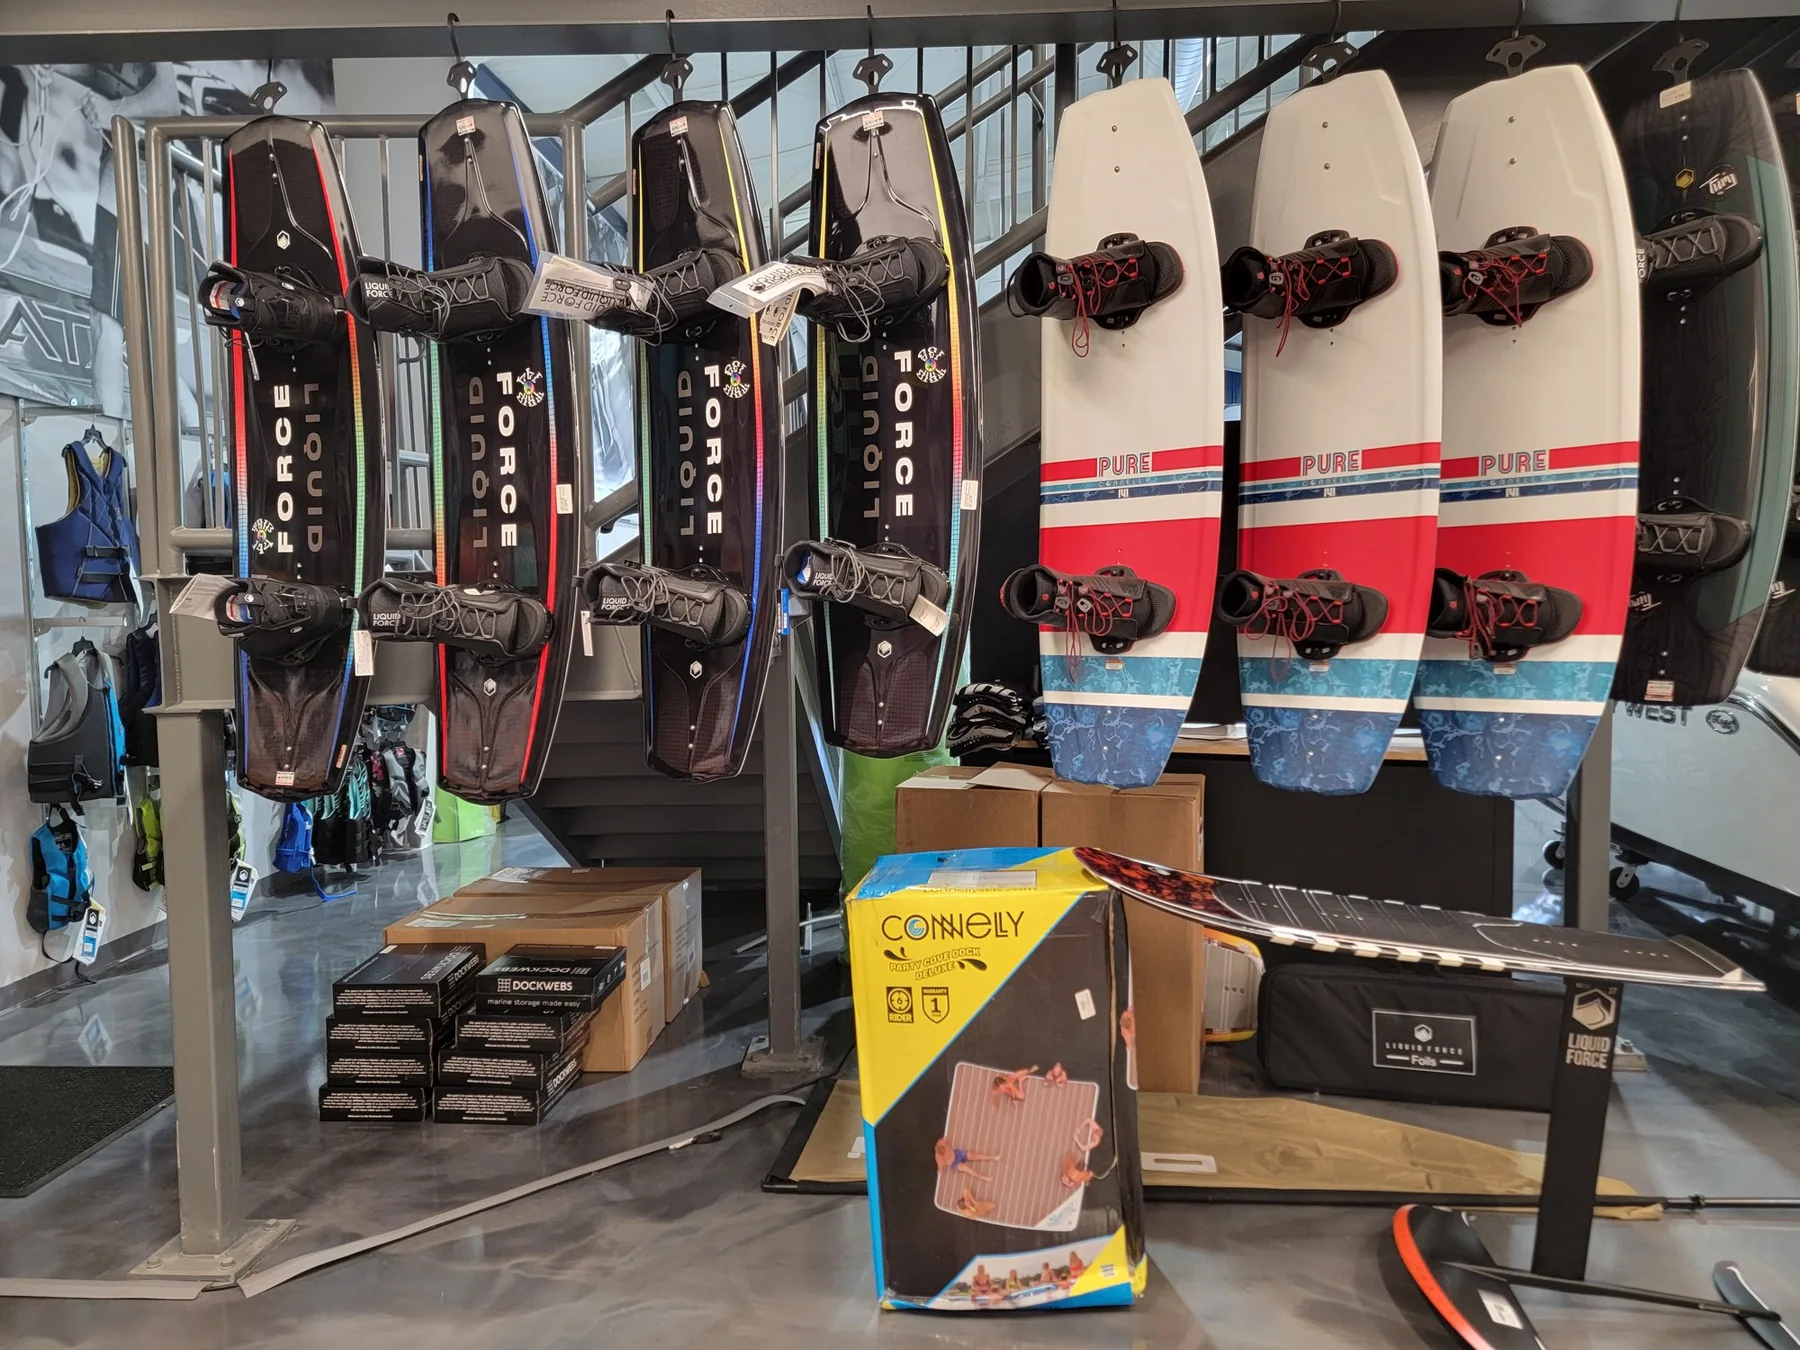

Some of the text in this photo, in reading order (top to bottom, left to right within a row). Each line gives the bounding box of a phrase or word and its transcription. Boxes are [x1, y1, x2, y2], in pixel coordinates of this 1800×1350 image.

[541, 291, 583, 309] FORCE
[862, 350, 914, 518] LIQUID FORCE
[468, 371, 517, 547] LIQUID FORCE
[677, 365, 723, 535] LIQUID FORCE
[273, 383, 323, 553] LIQUID FORCE
[1098, 451, 1151, 477] PURE
[1301, 449, 1360, 476] PURE
[1480, 449, 1547, 476] PURE
[602, 597, 627, 605] LIQUID
[1624, 701, 1693, 727] WEST
[889, 947, 981, 972] PARTY COVE DOCK
[915, 960, 955, 981] DELUXE
[512, 980, 573, 992] DOCKWEBS
[513, 999, 540, 1008] storage
[564, 1001, 581, 1009] easy
[930, 997, 942, 1013] 1
[889, 1012, 913, 1022] RIDER
[1568, 1032, 1611, 1053] LIQUID
[1411, 1055, 1437, 1067] Foils
[1565, 1048, 1609, 1069] FORCE
